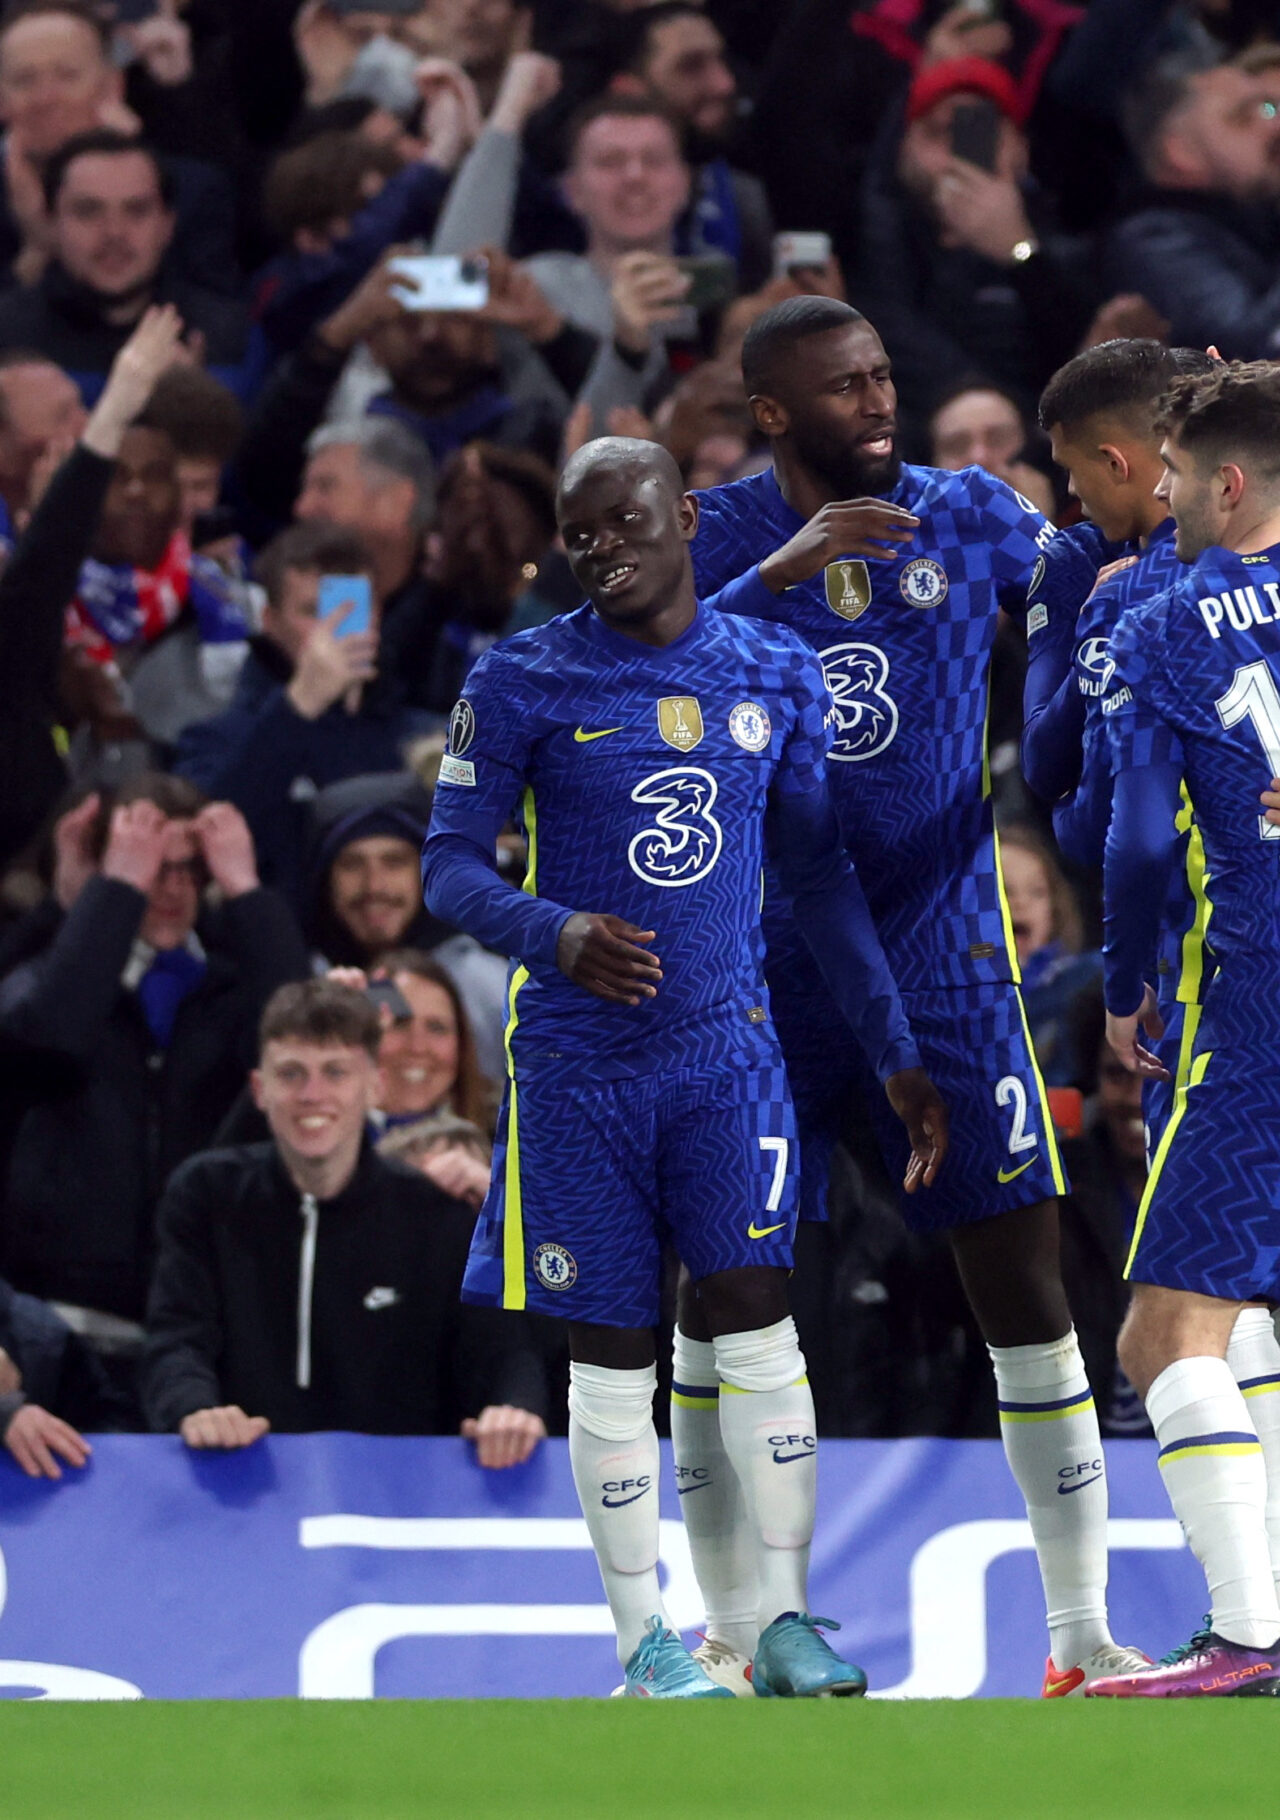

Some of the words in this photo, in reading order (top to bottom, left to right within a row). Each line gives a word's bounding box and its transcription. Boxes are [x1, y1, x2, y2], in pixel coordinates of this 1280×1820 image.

[1241, 555, 1271, 564] CFC
[840, 597, 860, 607] FIFA
[673, 731, 693, 739] FIFA
[628, 766, 722, 887] 3
[995, 1075, 1038, 1154] 2
[758, 1136, 788, 1211] 7
[768, 1435, 816, 1448] CFC
[1057, 1459, 1102, 1478] CFC
[601, 1475, 651, 1492] CFC
[1200, 1662, 1273, 1691] ULTRA
